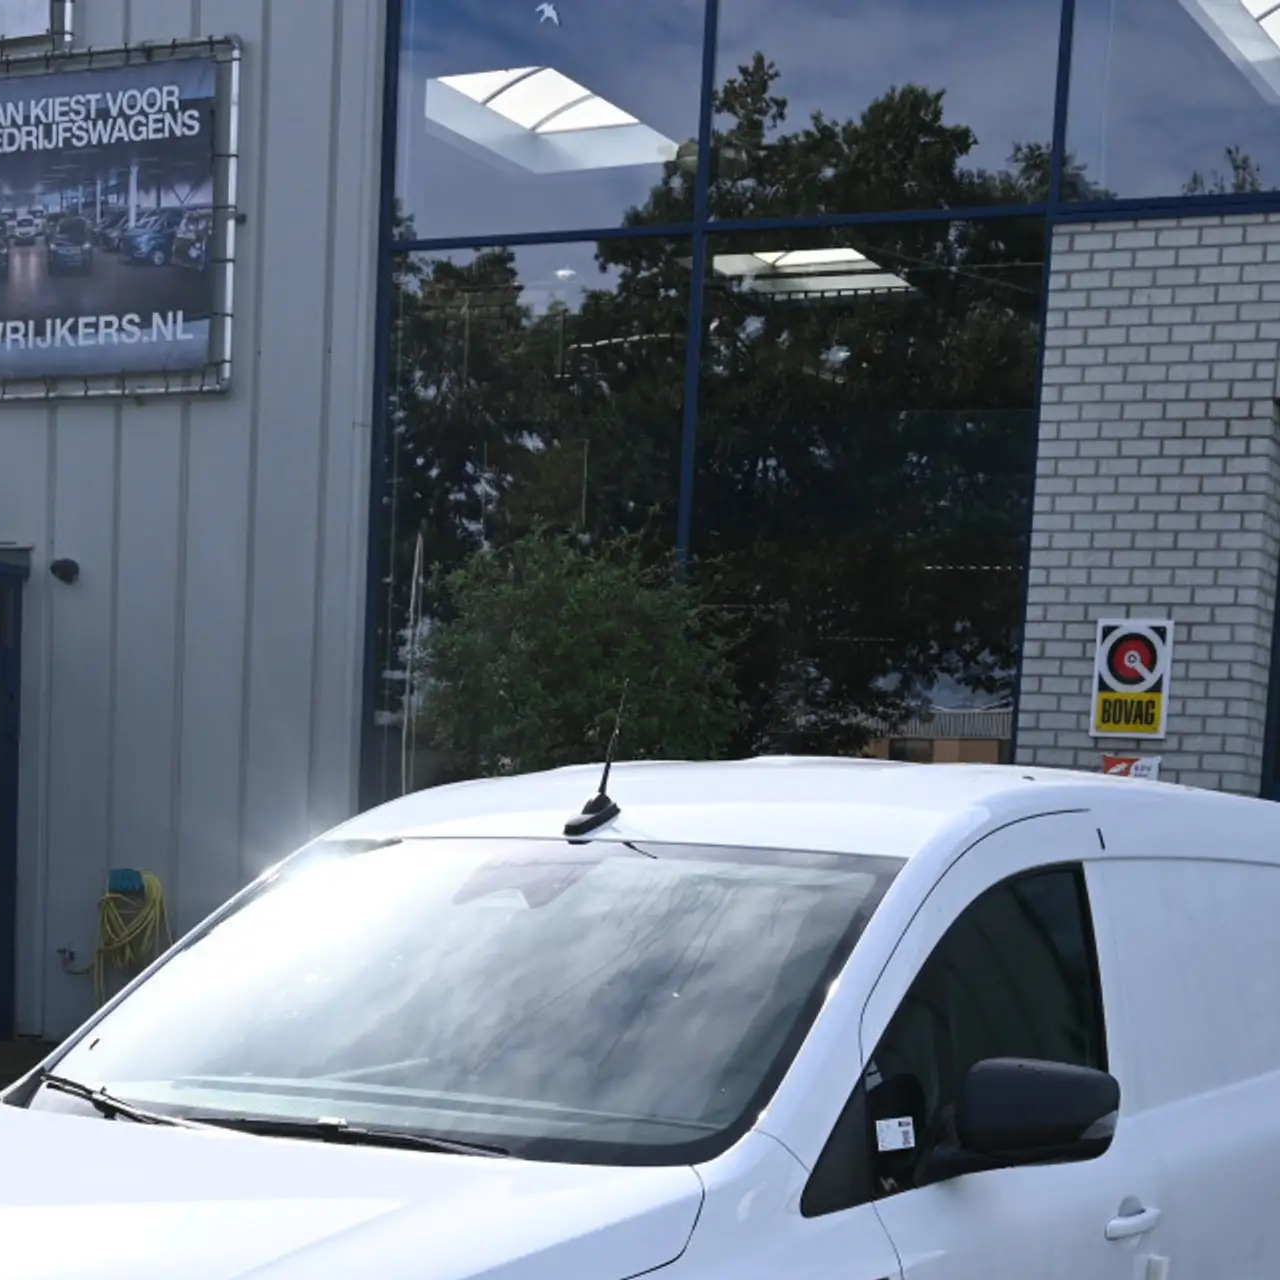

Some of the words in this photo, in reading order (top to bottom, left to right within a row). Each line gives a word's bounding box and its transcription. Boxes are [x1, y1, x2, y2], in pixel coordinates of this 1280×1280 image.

[30, 93, 101, 125] KIEST
[106, 85, 181, 116] VOOR
[1102, 697, 1156, 726] BOVAG
